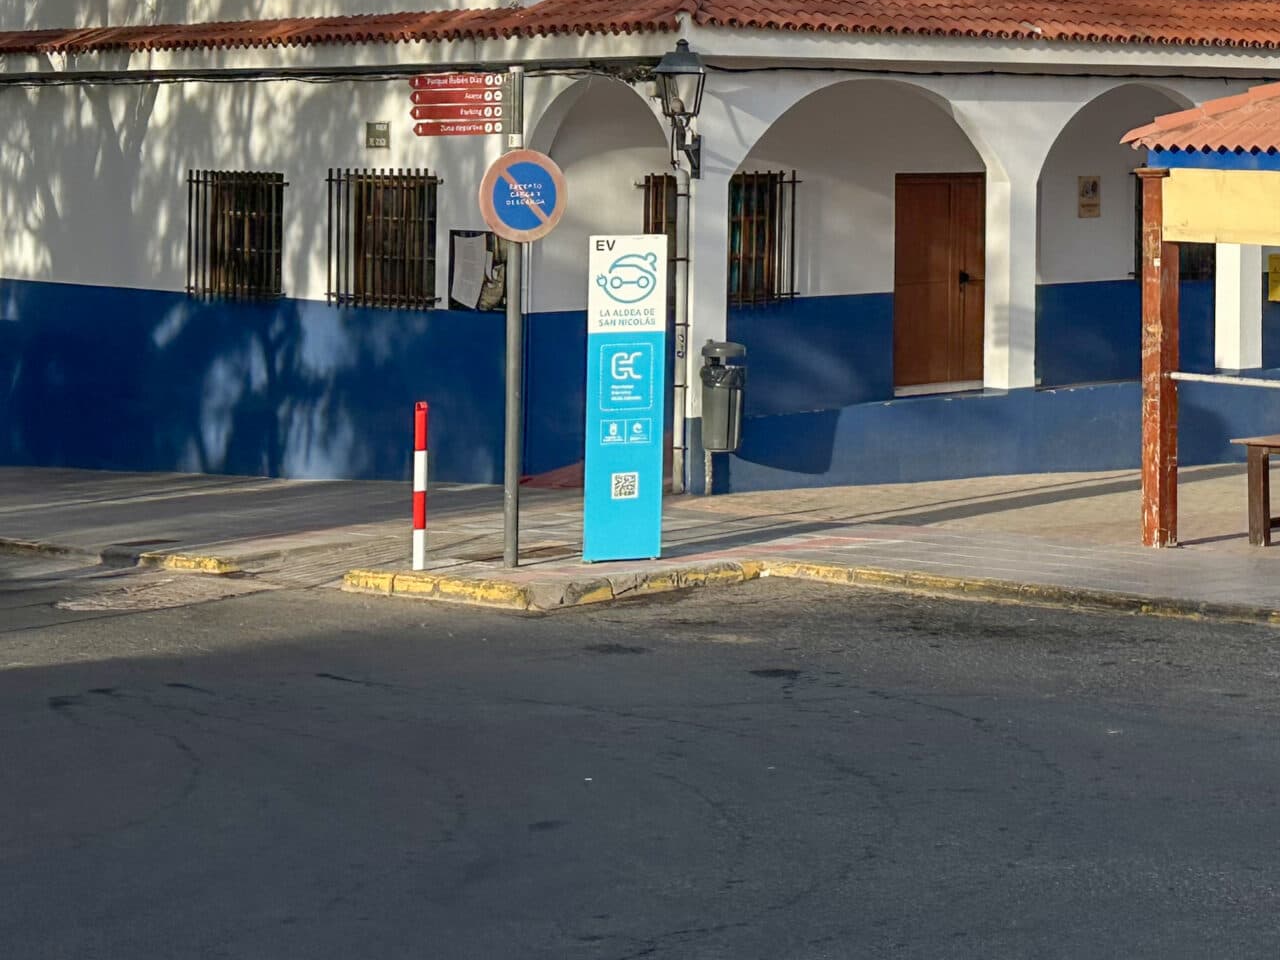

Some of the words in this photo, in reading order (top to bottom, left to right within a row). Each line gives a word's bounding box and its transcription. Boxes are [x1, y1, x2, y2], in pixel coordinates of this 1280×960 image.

[596, 240, 616, 251] EV
[599, 309, 610, 317] LA
[612, 308, 641, 317] ALDEA
[643, 308, 656, 316] DE
[598, 319, 616, 327] SAN
